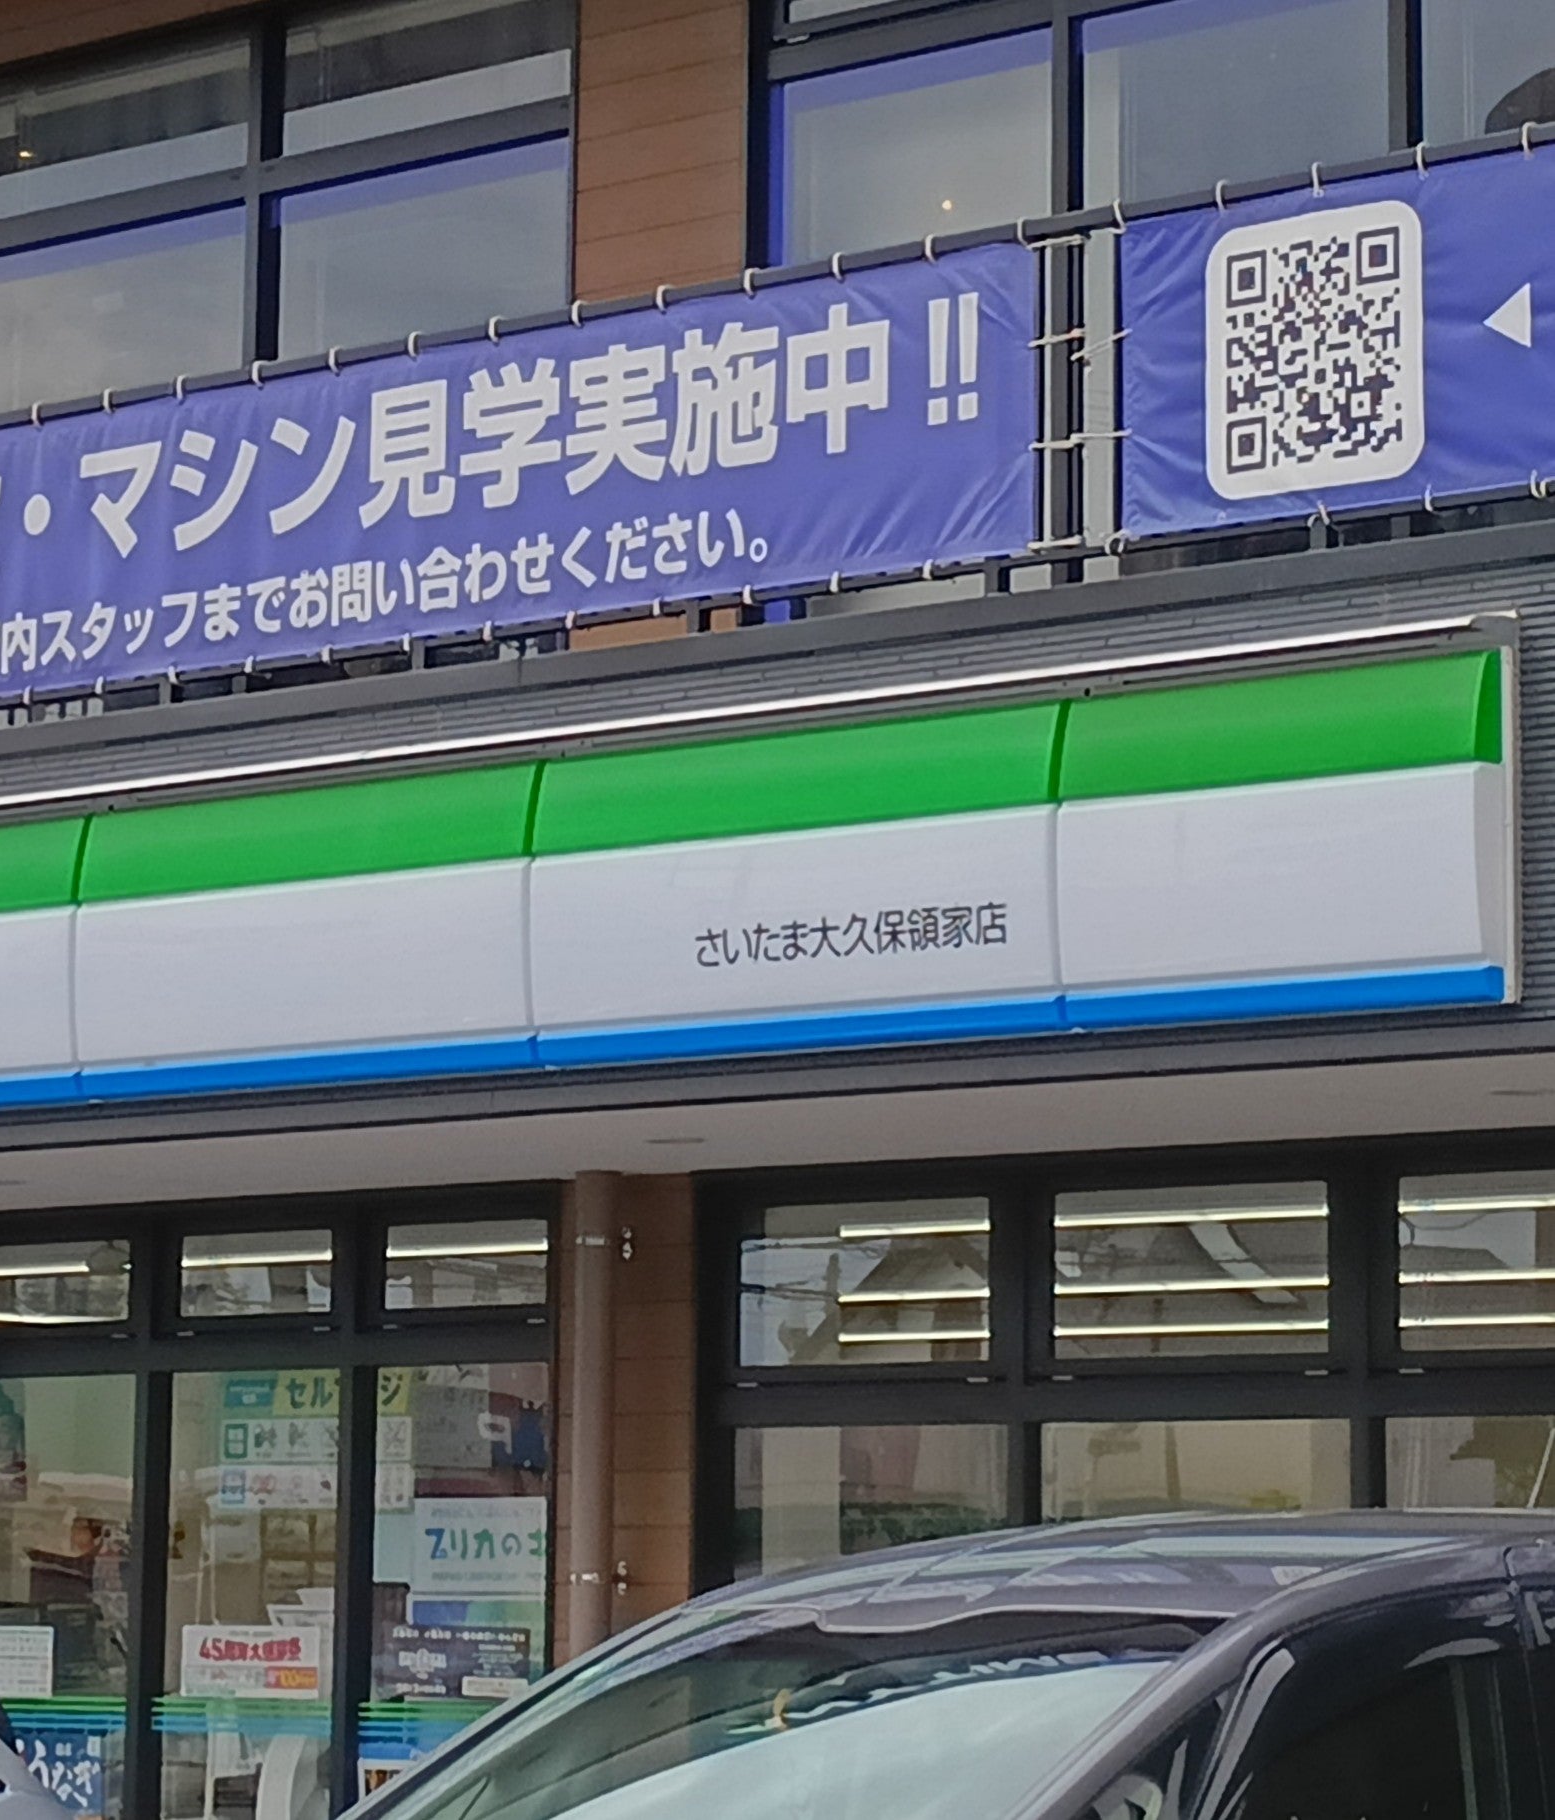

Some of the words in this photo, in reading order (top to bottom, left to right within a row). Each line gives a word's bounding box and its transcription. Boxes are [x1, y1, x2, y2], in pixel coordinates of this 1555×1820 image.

[695, 902, 1009, 967] さいたま大久保領家店
